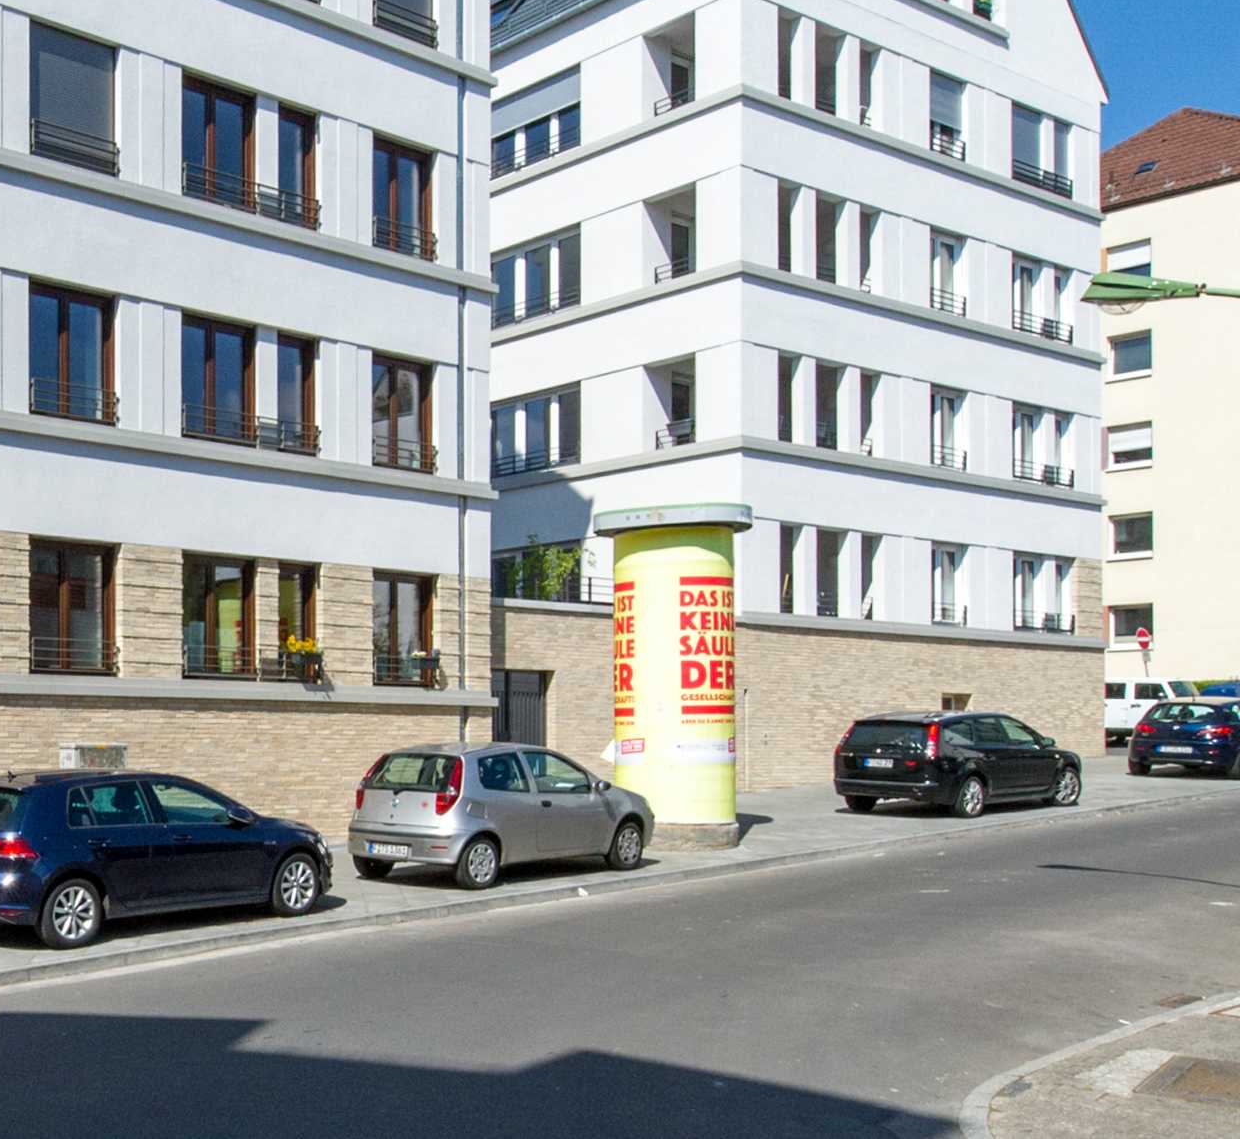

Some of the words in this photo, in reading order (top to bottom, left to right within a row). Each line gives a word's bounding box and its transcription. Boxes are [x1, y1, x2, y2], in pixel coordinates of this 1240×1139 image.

[617, 595, 634, 613] IST
[680, 590, 718, 607] DAS
[680, 660, 735, 689] DER
